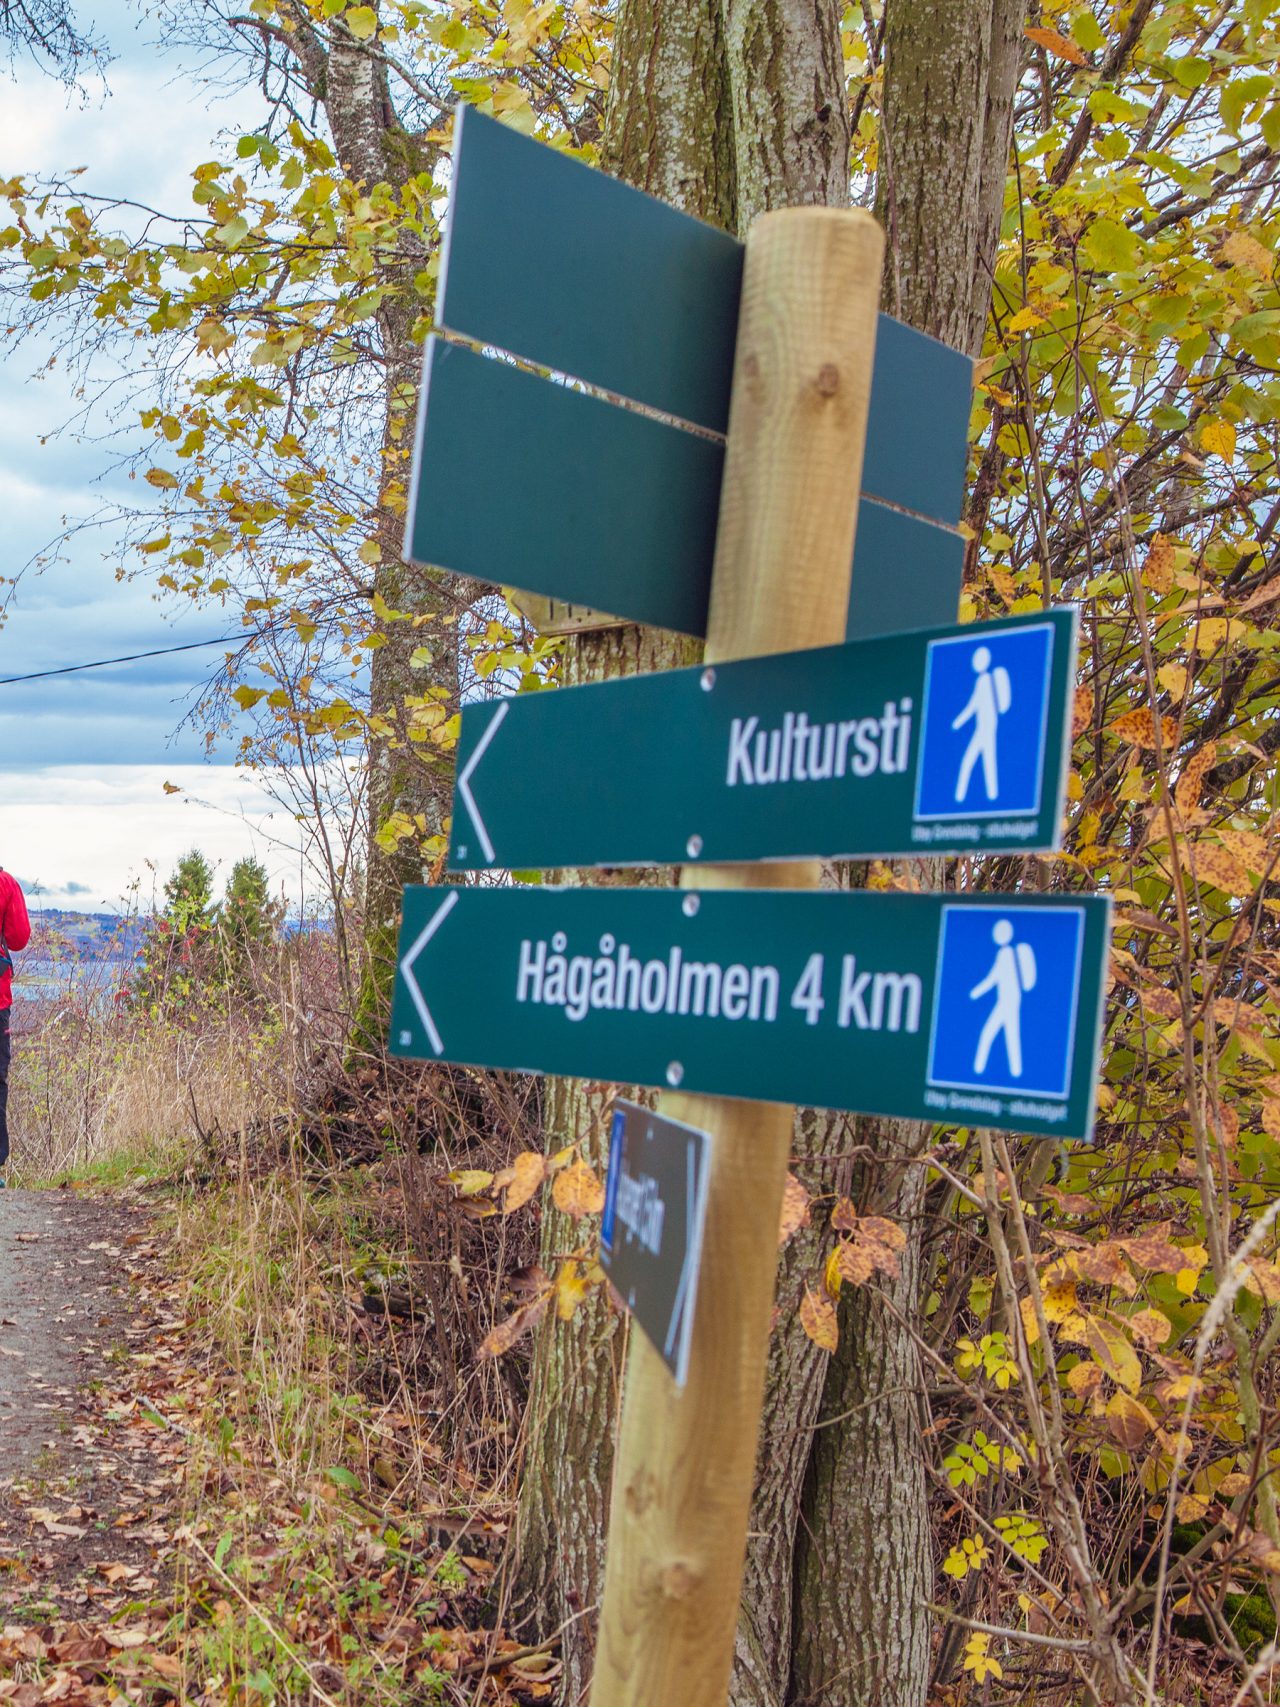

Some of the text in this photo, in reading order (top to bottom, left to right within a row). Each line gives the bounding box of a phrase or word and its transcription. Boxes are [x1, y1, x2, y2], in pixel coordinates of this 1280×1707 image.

[726, 697, 913, 787] Kultursti
[516, 931, 922, 1033] Hågåholmen 4 km
